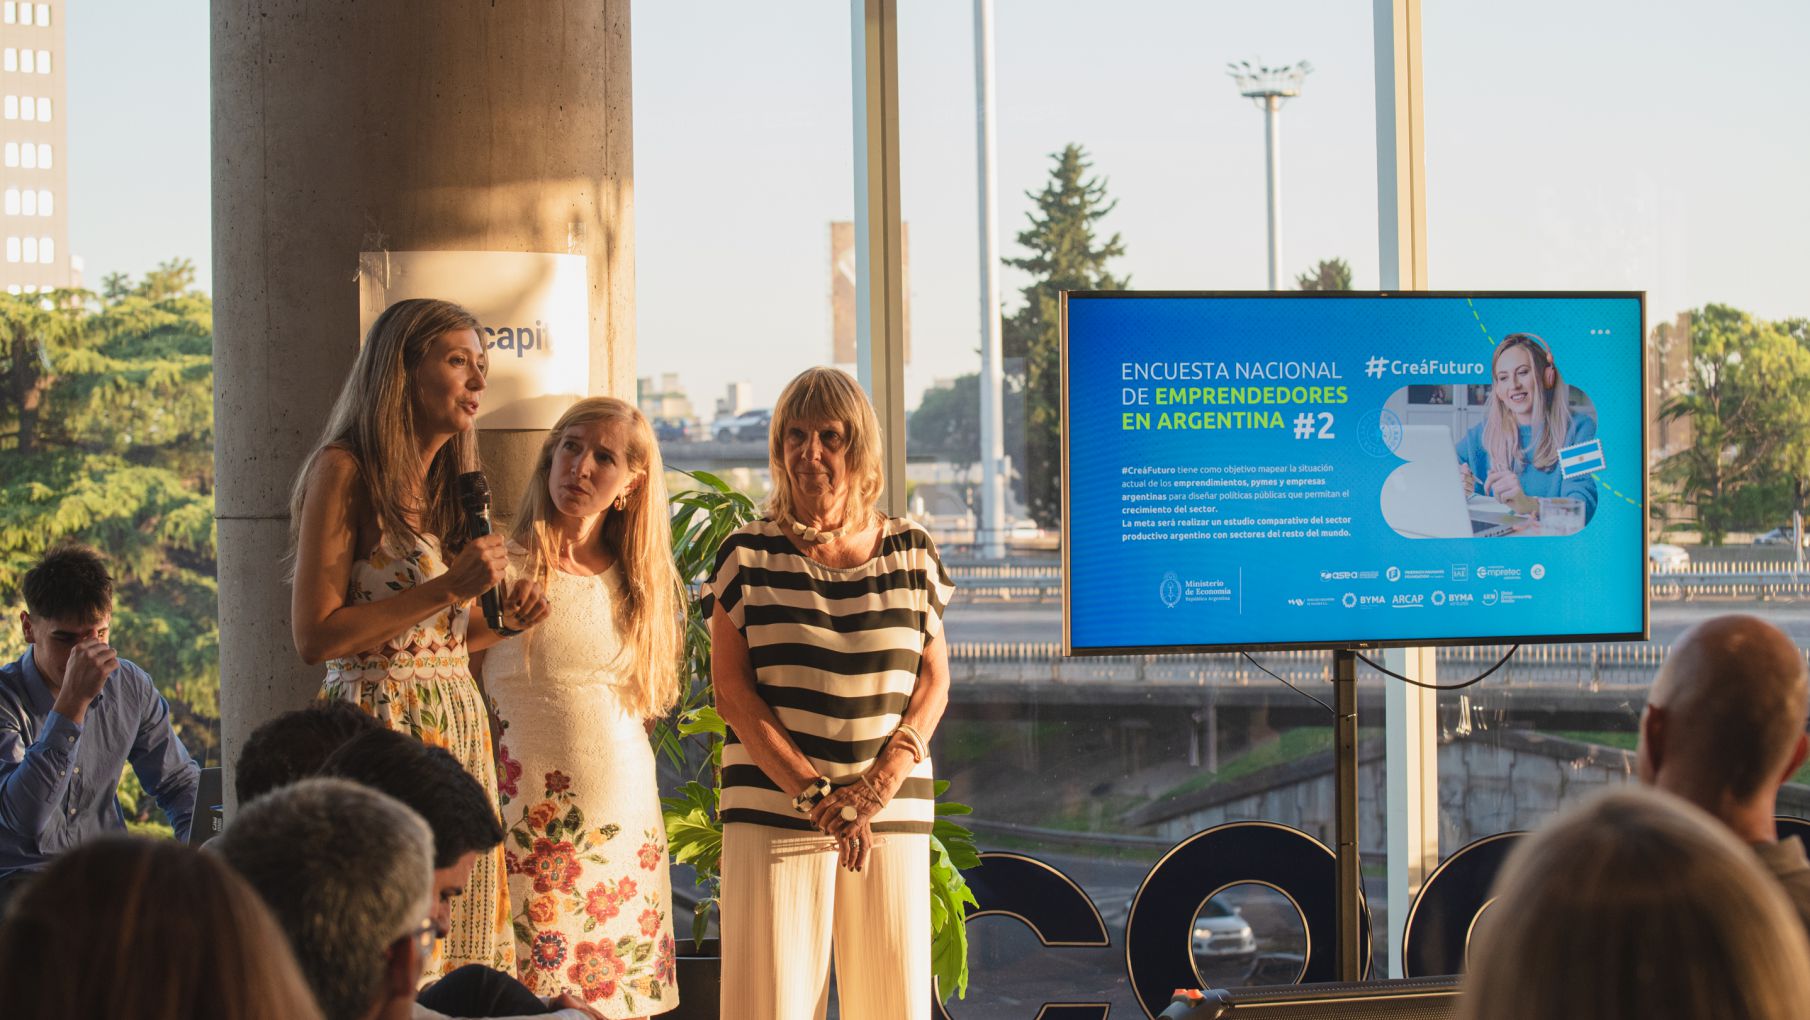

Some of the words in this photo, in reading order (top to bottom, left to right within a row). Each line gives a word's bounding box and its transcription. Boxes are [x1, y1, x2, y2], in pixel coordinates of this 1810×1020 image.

[1122, 362, 1230, 380] ENCUESTA
[1236, 361, 1342, 379] NACIONAL
[1365, 355, 1484, 379] #CreáFuturo
[1122, 388, 1149, 405] DE
[1156, 386, 1348, 405] EMPRENDEDORES
[1122, 412, 1150, 430] EN
[1157, 411, 1285, 429] ARGENTINA
[1293, 411, 1335, 440] #2
[1122, 466, 1176, 475] #CreáFuturo
[1177, 465, 1198, 474] tiene
[1200, 466, 1221, 474] como
[1224, 465, 1256, 475] objetivo
[1258, 465, 1287, 474] mapear
[1289, 464, 1297, 473] la
[1298, 463, 1334, 473] situación
[1122, 479, 1146, 488] actual
[1148, 479, 1158, 487] de
[1160, 479, 1172, 487] los
[1174, 478, 1249, 488] emprendimientos,
[1251, 479, 1277, 487] pymes
[1280, 479, 1284, 487] y
[1286, 478, 1325, 486] empresas
[1122, 493, 1167, 502] argentinas
[1168, 493, 1186, 501] para
[1188, 491, 1217, 500] diseñar
[1219, 491, 1252, 501] políticas
[1254, 490, 1286, 500] públicas
[1288, 491, 1304, 499] que
[1305, 490, 1340, 499] permitan
[1342, 489, 1349, 497] el
[1122, 506, 1172, 514] crecimiento
[1174, 505, 1187, 513] del
[1189, 505, 1218, 513] sector.
[1122, 519, 1132, 527] La
[1134, 519, 1155, 527] meta
[1157, 519, 1176, 527] será
[1177, 518, 1210, 526] realizar
[1224, 517, 1255, 525] estudio
[1257, 516, 1308, 526] comparativo
[1310, 516, 1323, 524] del
[1325, 516, 1351, 524] sector
[1122, 532, 1168, 542] productivo
[1170, 531, 1211, 541] argentino
[1230, 530, 1265, 538] sectores
[1267, 530, 1280, 538] del
[1282, 530, 1304, 538] resto
[1306, 529, 1319, 537] del
[1321, 529, 1351, 537] mundo.
[1196, 587, 1231, 595] Economía
[1360, 595, 1385, 604] BYMA
[1392, 594, 1424, 604] ARCAP
[1448, 594, 1474, 602] BYMA
